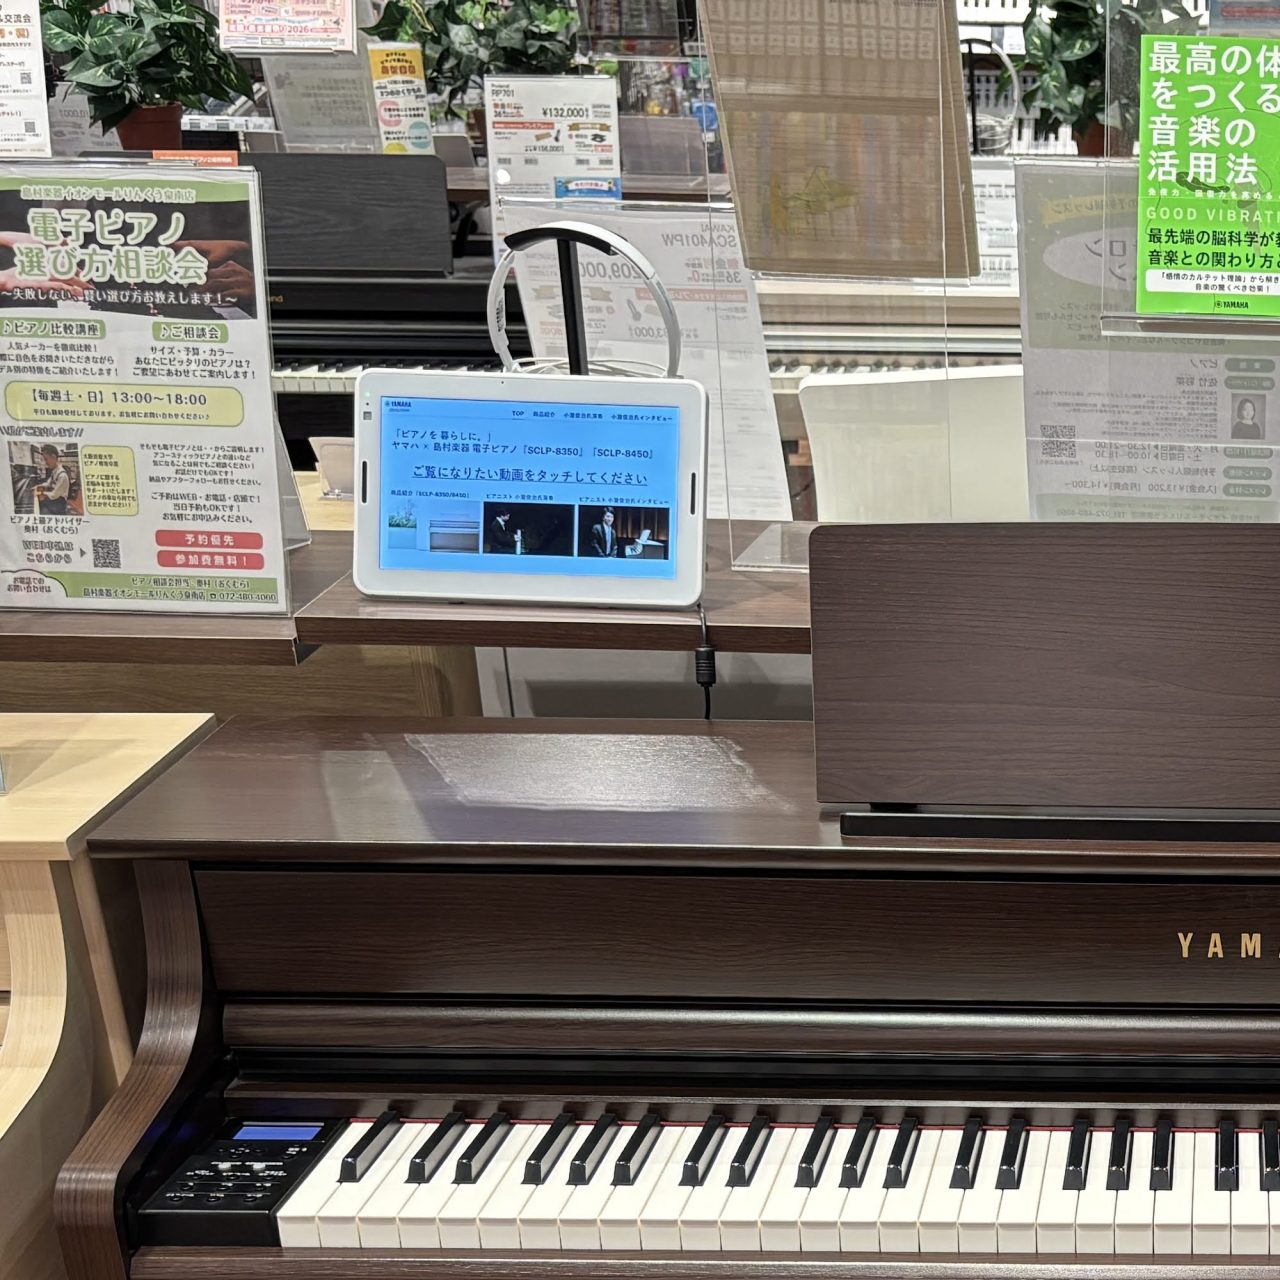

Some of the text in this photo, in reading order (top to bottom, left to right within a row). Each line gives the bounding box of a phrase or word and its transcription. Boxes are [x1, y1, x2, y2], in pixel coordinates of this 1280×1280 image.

[0, 13, 31, 23] 交流会
[287, 25, 311, 33] 2026
[1148, 113, 1256, 148] 音楽の
[1147, 150, 1258, 185] 活用法
[1146, 207, 1197, 221] GOOD
[28, 208, 186, 245] 電子ピアノ
[14, 244, 208, 285] 選び方相談会
[1223, 301, 1249, 309] YAMAHA
[392, 440, 419, 449] ヤマハ
[433, 442, 470, 453] 島村楽器
[412, 464, 648, 485] ご覧になりたい動画をタッチしてください
[184, 533, 235, 546] 予約優先
